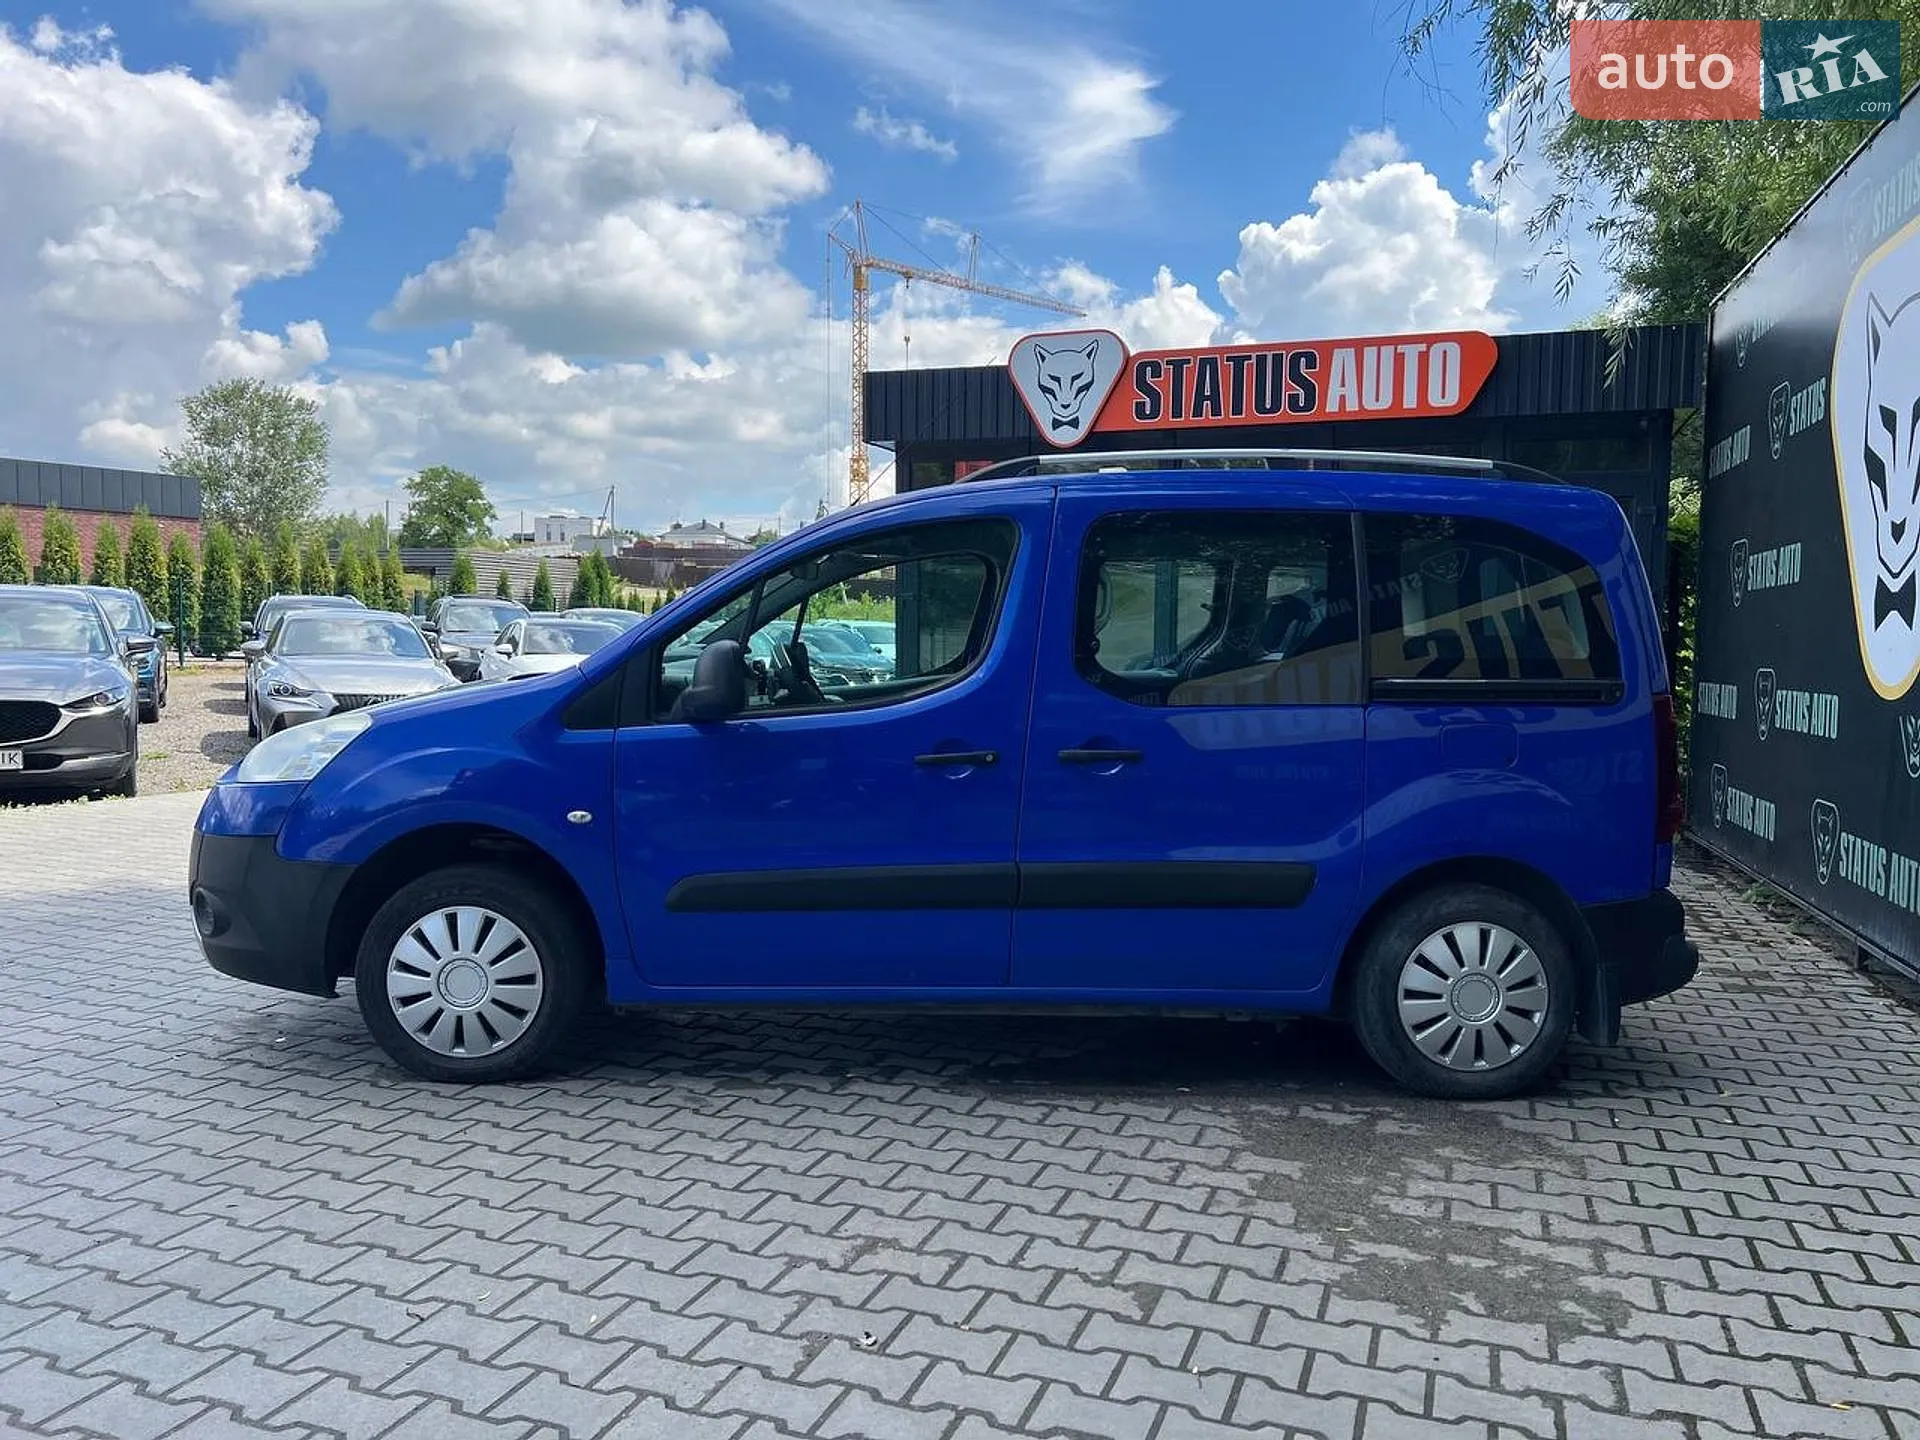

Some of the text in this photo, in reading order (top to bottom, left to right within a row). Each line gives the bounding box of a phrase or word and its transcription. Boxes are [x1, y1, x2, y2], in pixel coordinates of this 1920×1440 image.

[1132, 341, 1462, 423] STATUS AUTO
[1789, 376, 1826, 436] STATUS
[1747, 542, 1801, 591] STATUS AUTO
[1719, 684, 1738, 720] AUTO
[1774, 689, 1839, 739] STATUS AUTO
[1726, 786, 1776, 842] STATUS AUTO
[1839, 832, 1887, 897] STATUS
